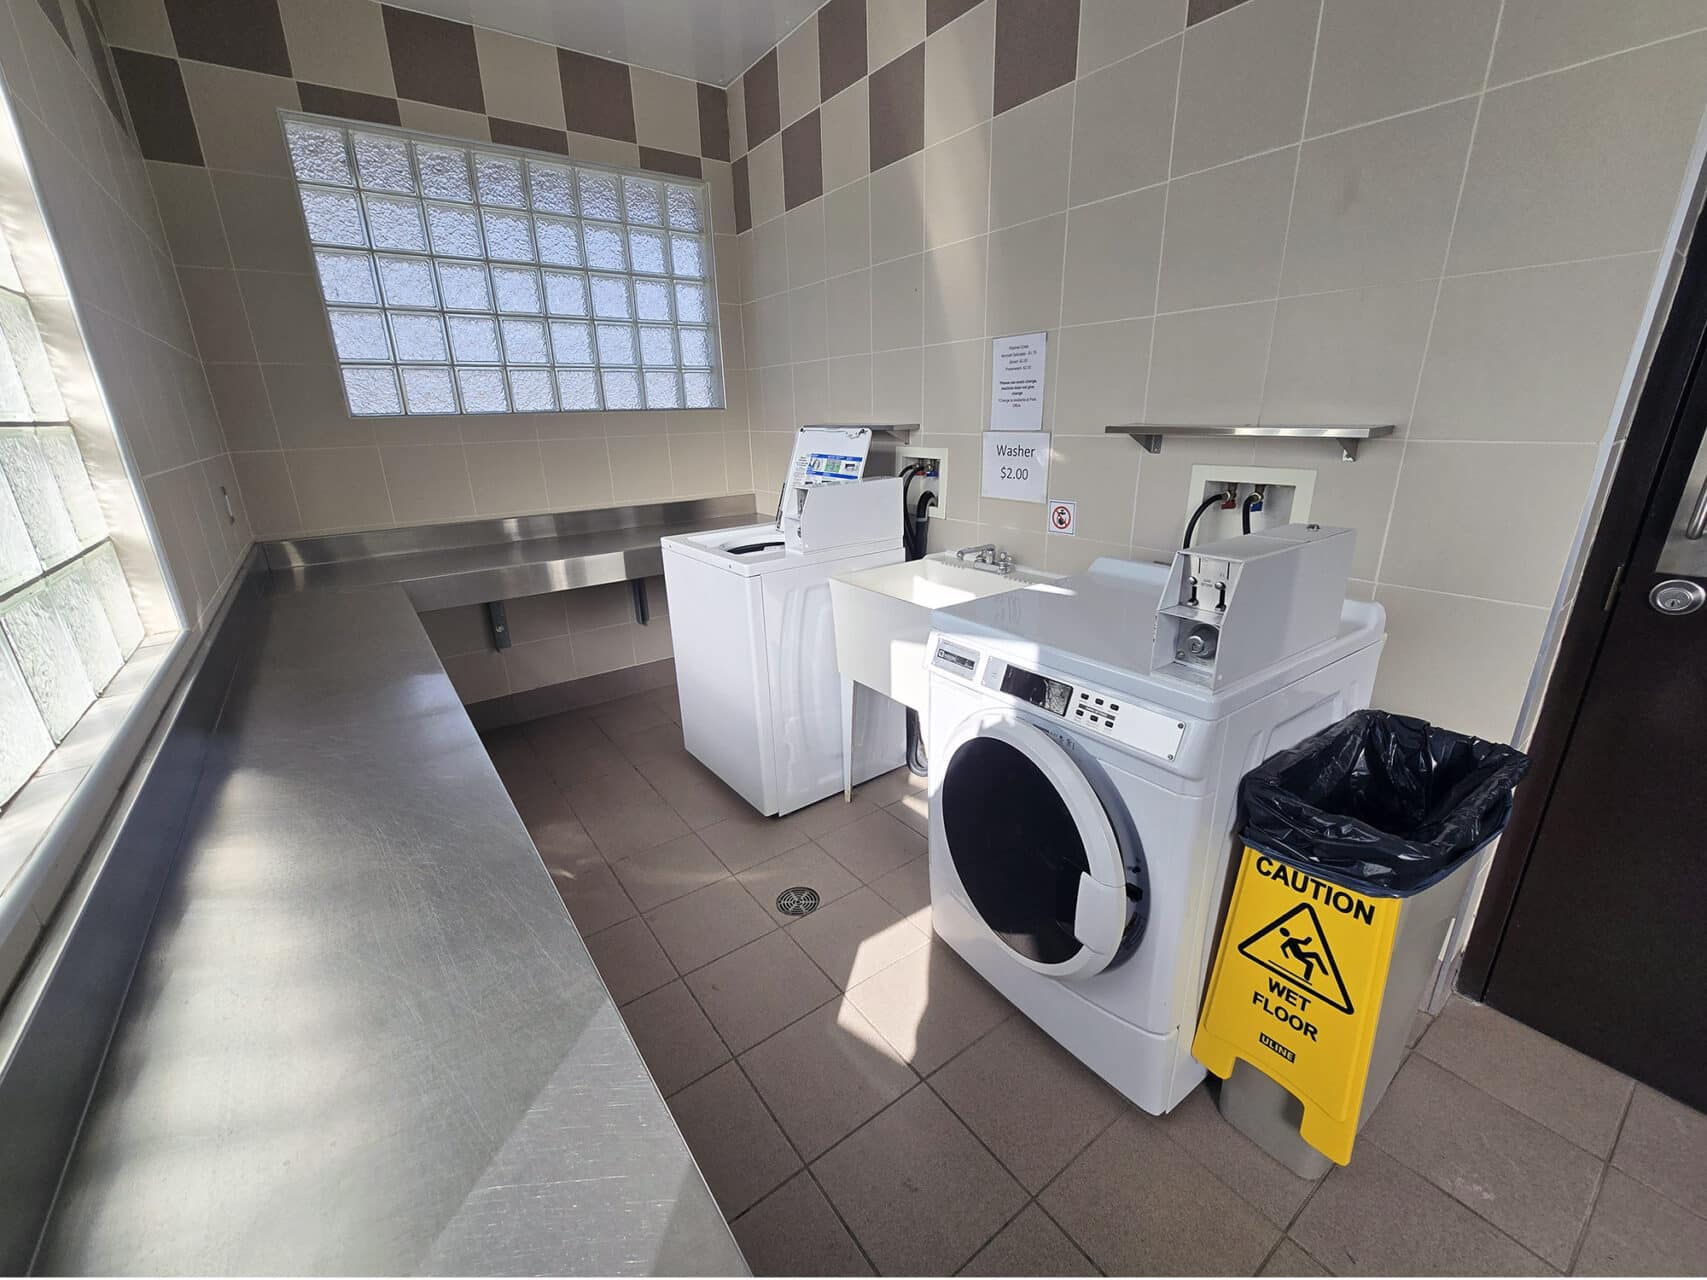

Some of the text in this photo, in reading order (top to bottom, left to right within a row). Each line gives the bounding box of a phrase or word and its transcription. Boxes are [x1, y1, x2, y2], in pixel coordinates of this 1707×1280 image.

[996, 444, 1036, 458] Washer
[1000, 466, 1029, 481] $2.00
[1256, 856, 1376, 926] CAUTION
[1268, 976, 1312, 1012] WET
[1252, 990, 1319, 1042] FLOOR
[1260, 1033, 1296, 1063] ULINE
